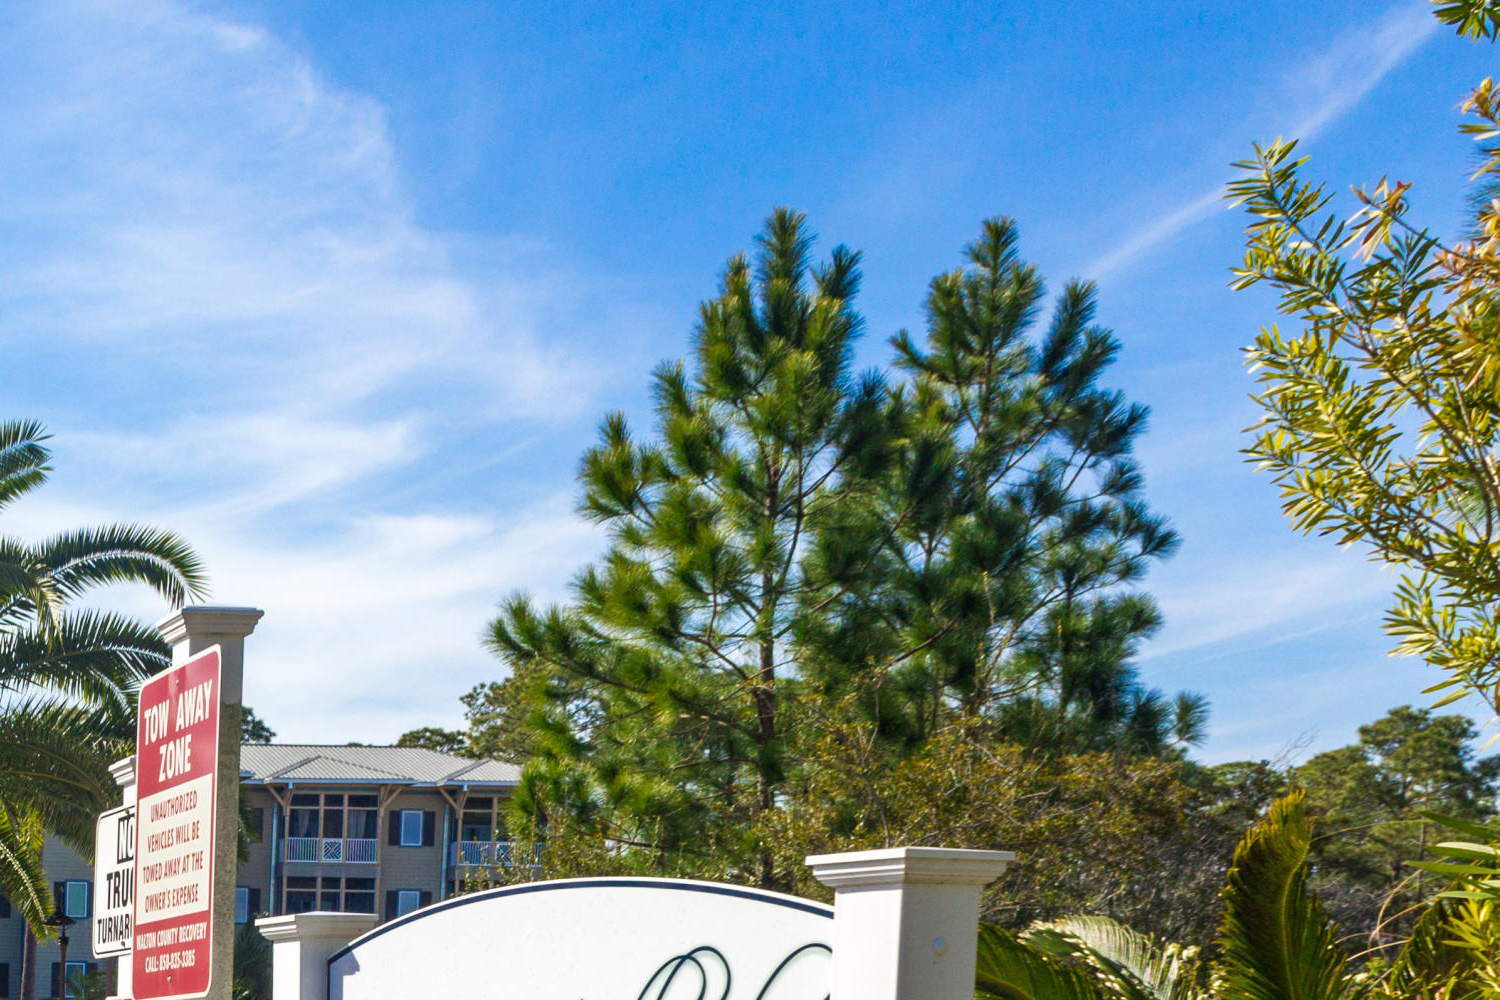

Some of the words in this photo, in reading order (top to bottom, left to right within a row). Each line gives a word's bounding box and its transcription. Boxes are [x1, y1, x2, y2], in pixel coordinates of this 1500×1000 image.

[144, 699, 170, 746] TOW
[175, 679, 212, 732] AWAY
[158, 733, 192, 783] ZONE
[150, 790, 198, 823] UNAUTHORIZED
[147, 828, 174, 853] VEHICLES
[175, 824, 190, 845] WILL
[192, 820, 200, 840] BE
[142, 862, 162, 885] TOWED
[164, 857, 181, 879] AWAY
[182, 854, 190, 875] AT
[192, 850, 203, 871] THE
[144, 888, 171, 913] OWNER'S
[172, 883, 199, 908] EXPENSE
[97, 914, 132, 944] TURNAR
[136, 931, 157, 951] WALTON
[157, 927, 179, 947] COUNTY
[178, 921, 208, 944] RECOVERY
[145, 956, 159, 973] CALL:
